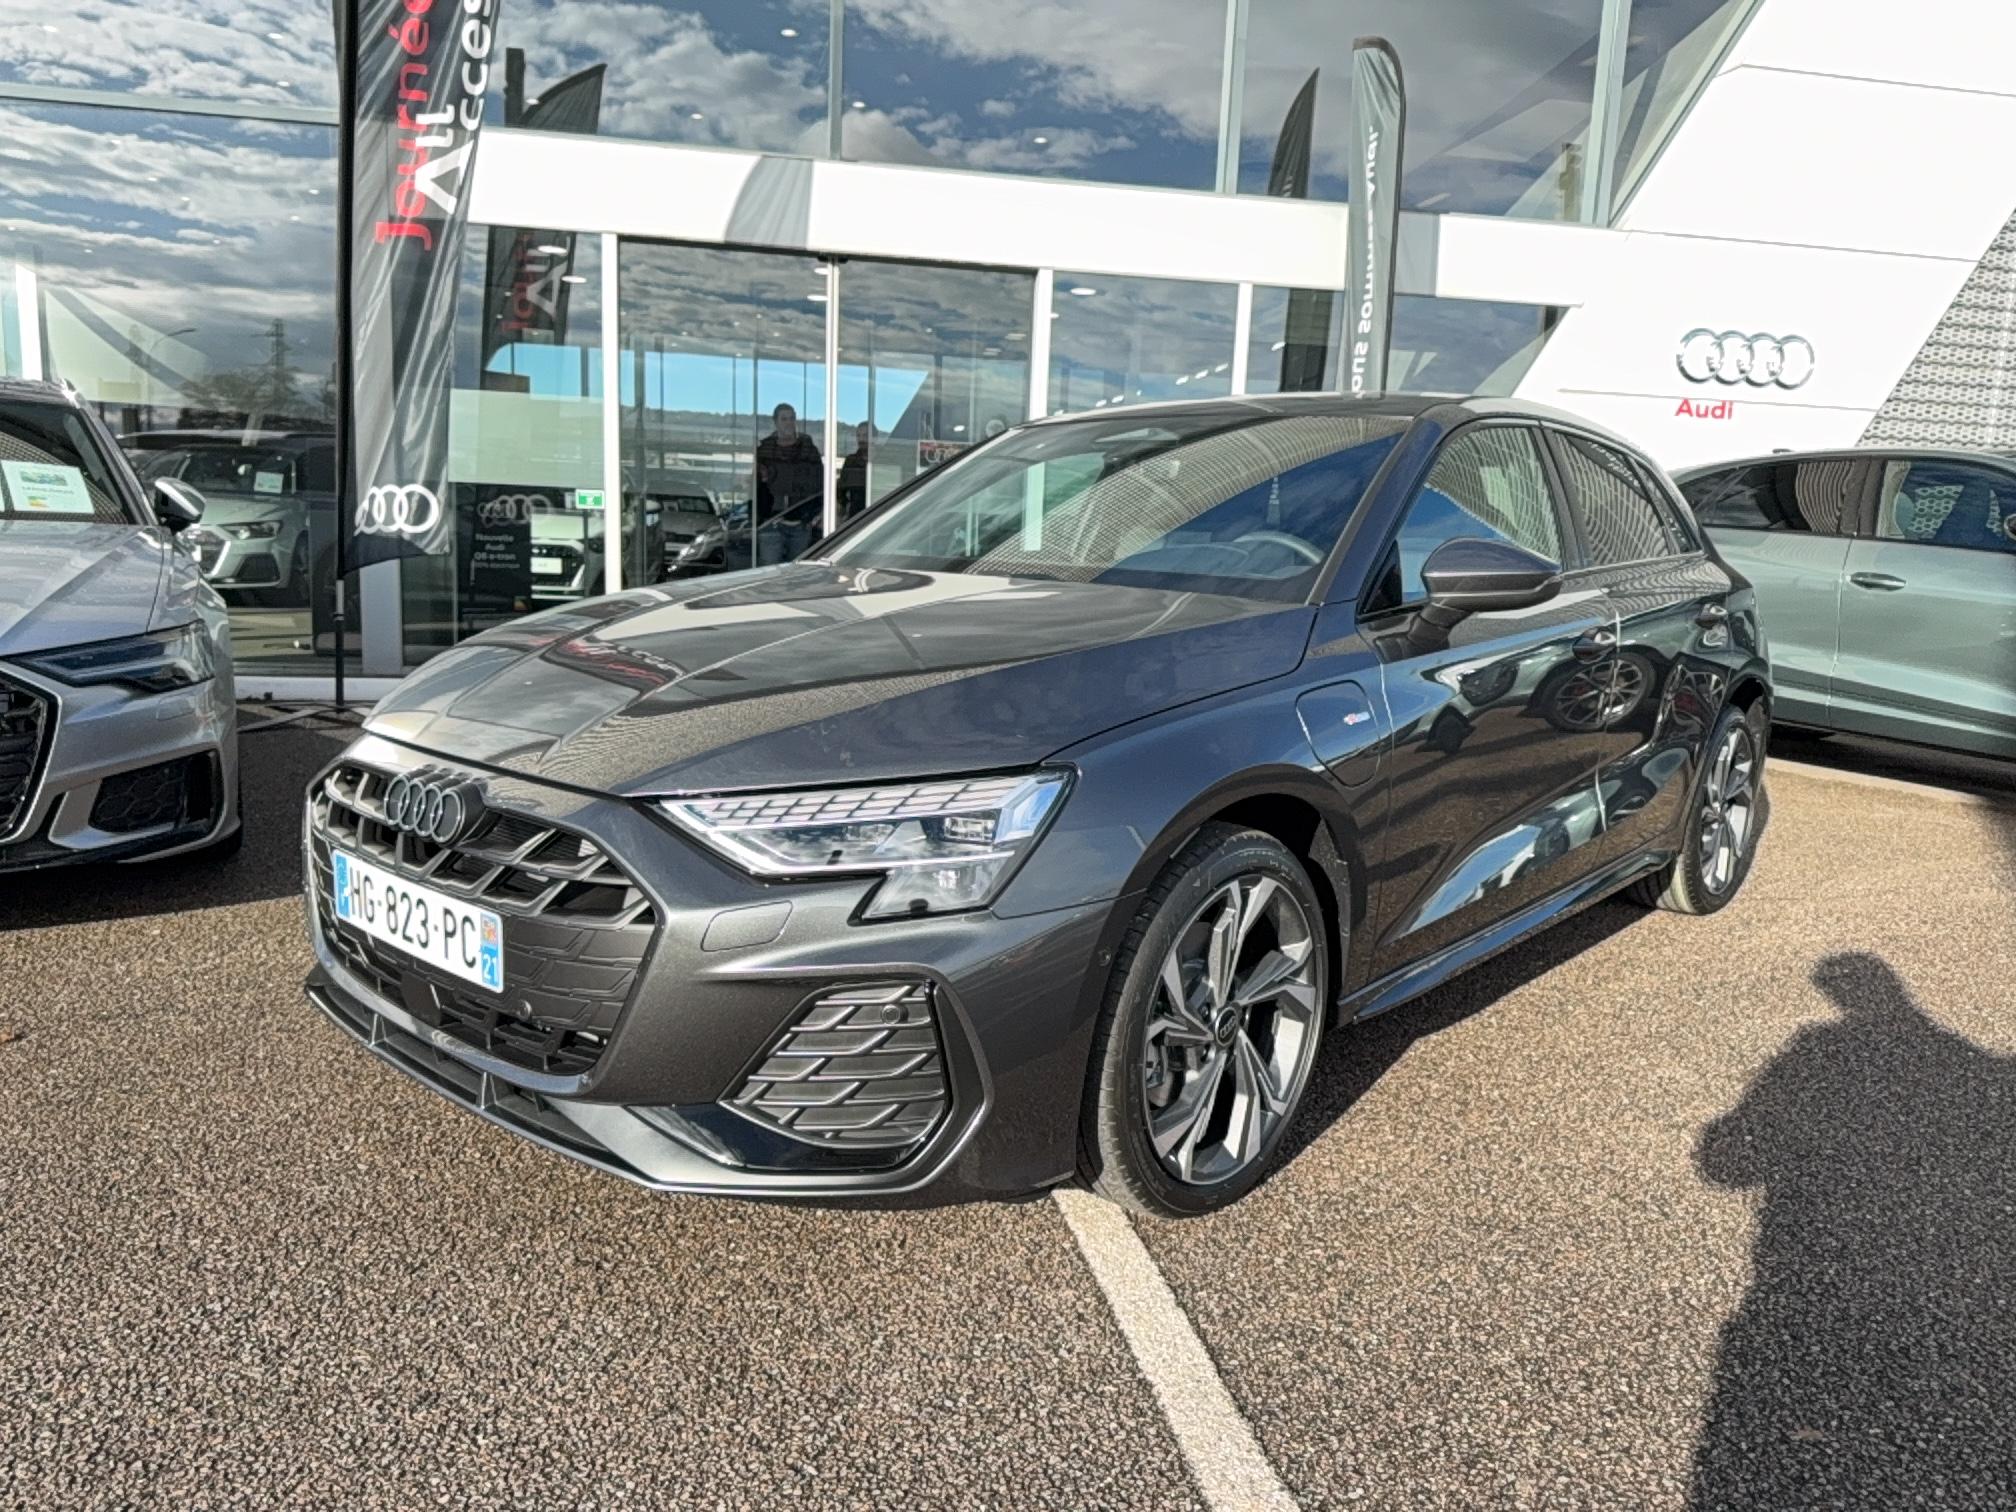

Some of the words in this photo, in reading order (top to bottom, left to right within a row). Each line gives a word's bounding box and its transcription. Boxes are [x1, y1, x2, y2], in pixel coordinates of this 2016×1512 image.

[1674, 397, 1734, 420] Audi
[350, 868, 477, 967] HG-823-PC
[482, 953, 498, 986] 21
